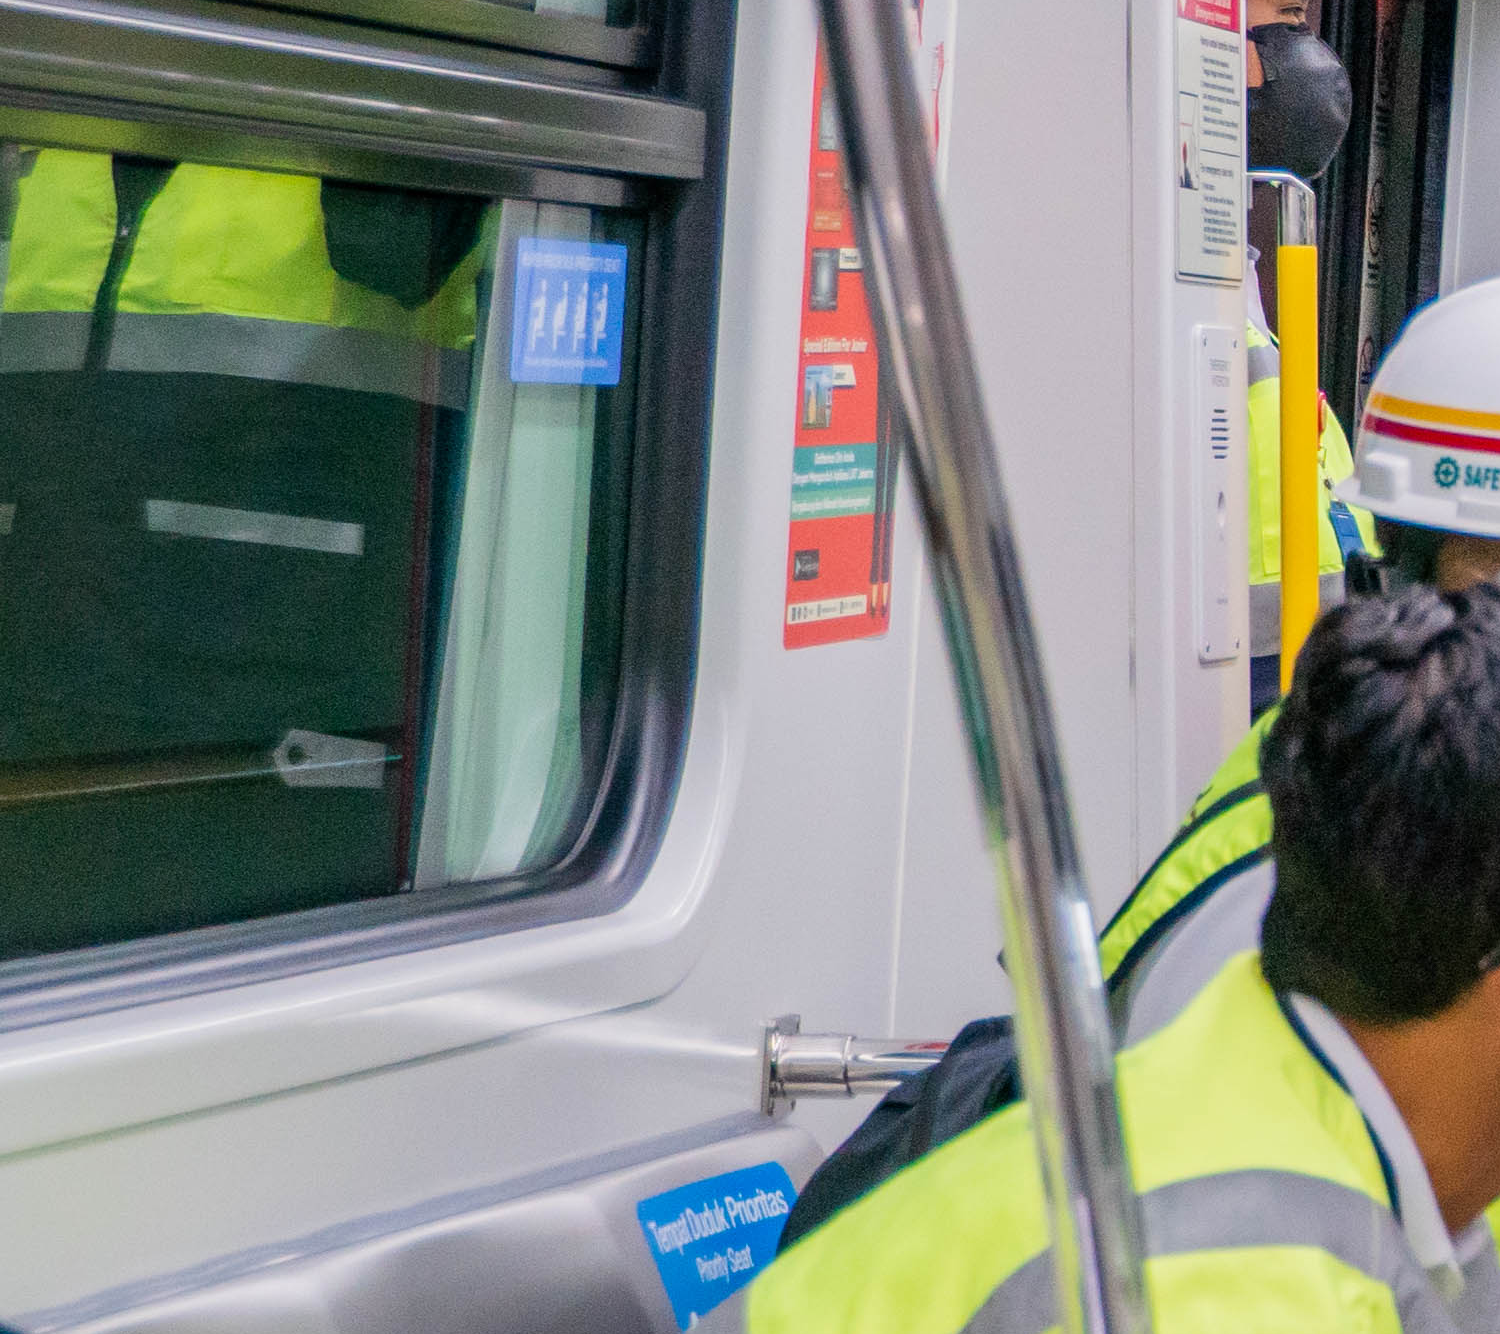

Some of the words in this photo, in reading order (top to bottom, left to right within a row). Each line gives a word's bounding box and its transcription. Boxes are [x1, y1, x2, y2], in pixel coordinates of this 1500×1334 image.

[648, 1211, 693, 1256] Tempat
[686, 1199, 730, 1241] Duduk
[724, 1188, 790, 1228] Prioritas
[695, 1251, 730, 1283] Priority
[727, 1244, 754, 1273] Seat
